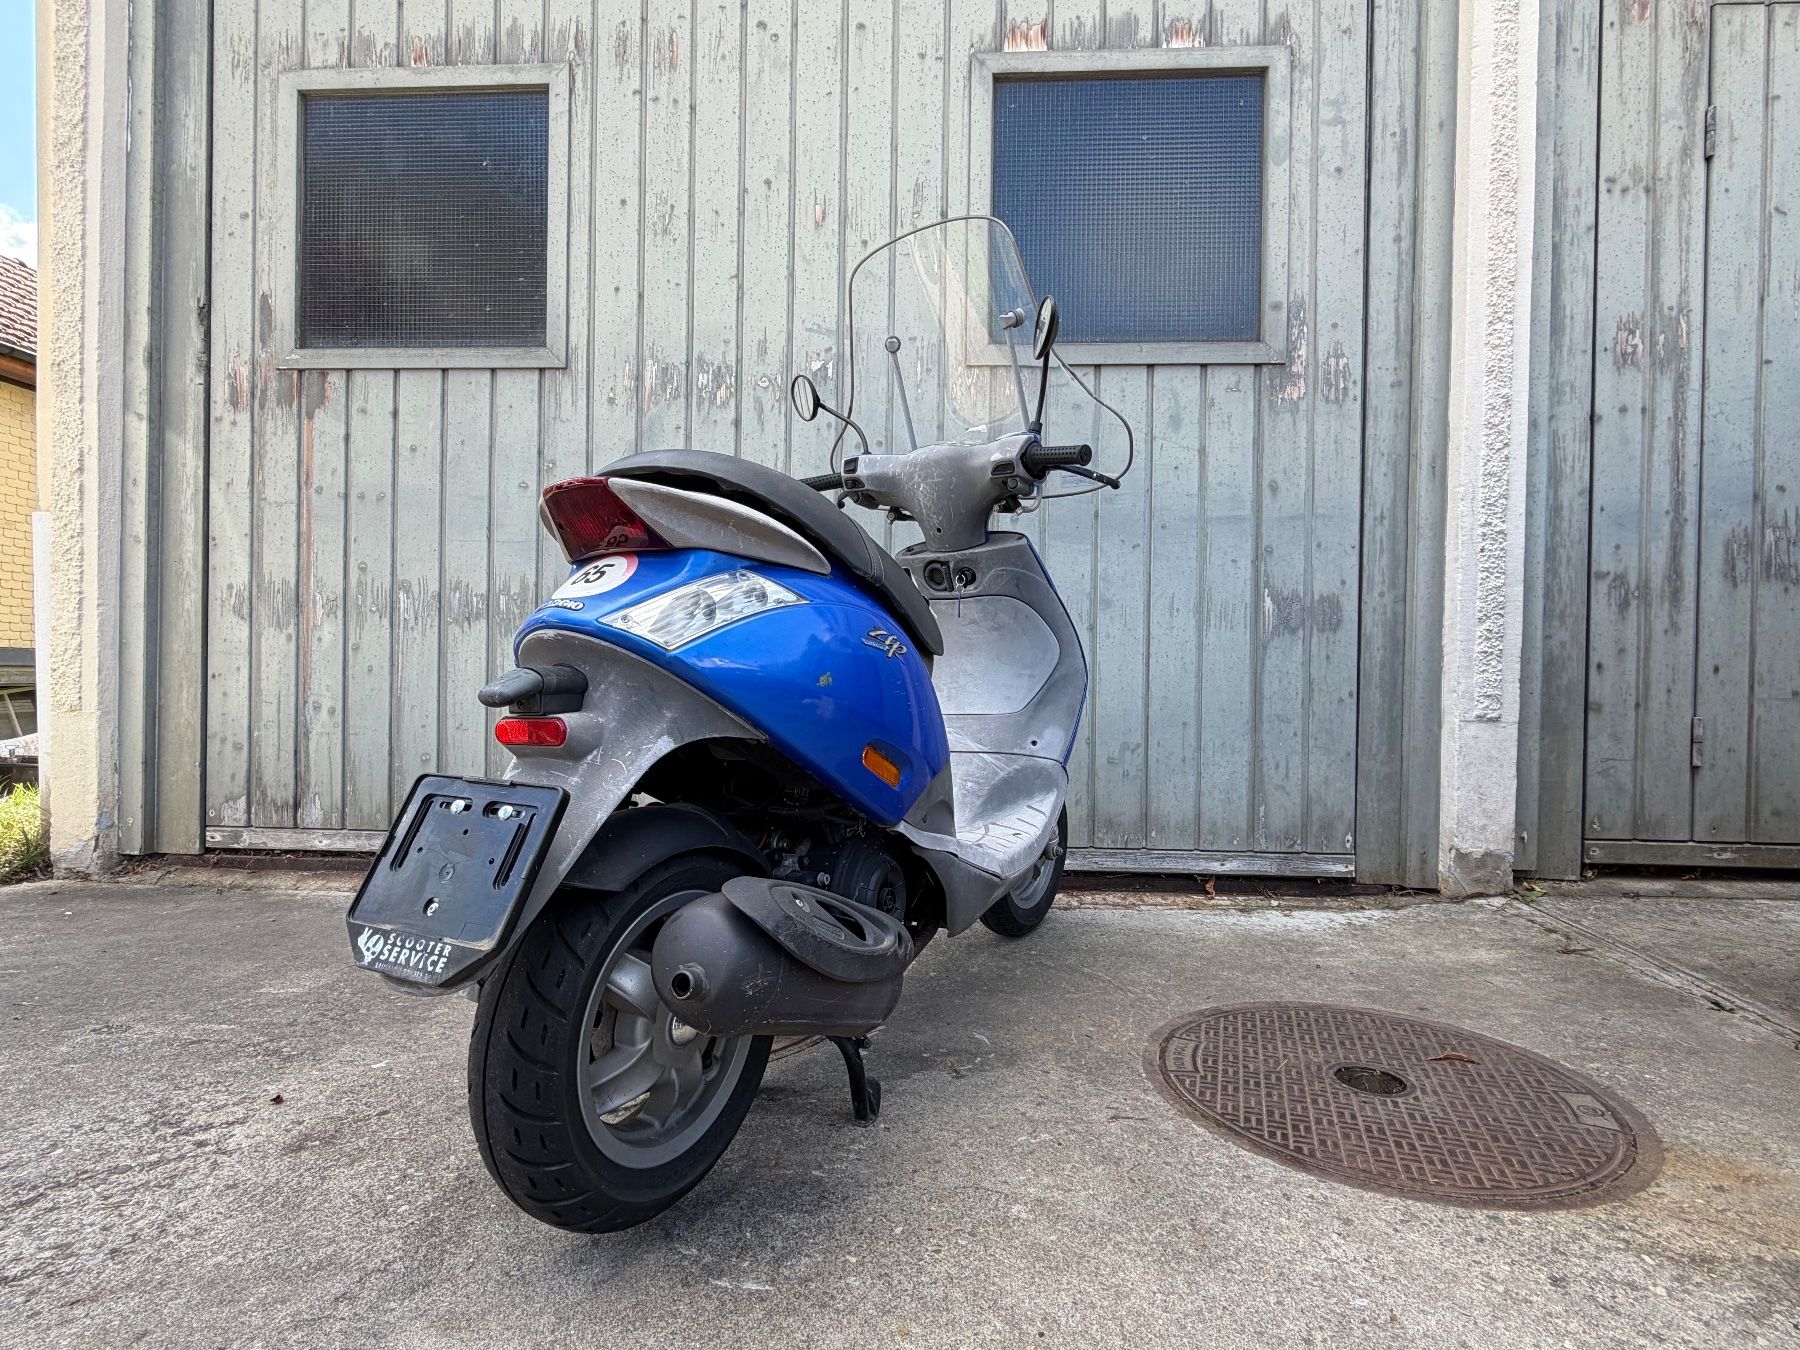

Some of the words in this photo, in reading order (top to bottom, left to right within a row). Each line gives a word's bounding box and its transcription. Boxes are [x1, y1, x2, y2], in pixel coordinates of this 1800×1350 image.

[570, 563, 616, 585] 65
[387, 933, 452, 957] SCOOTER
[379, 944, 448, 974] SERVICE
